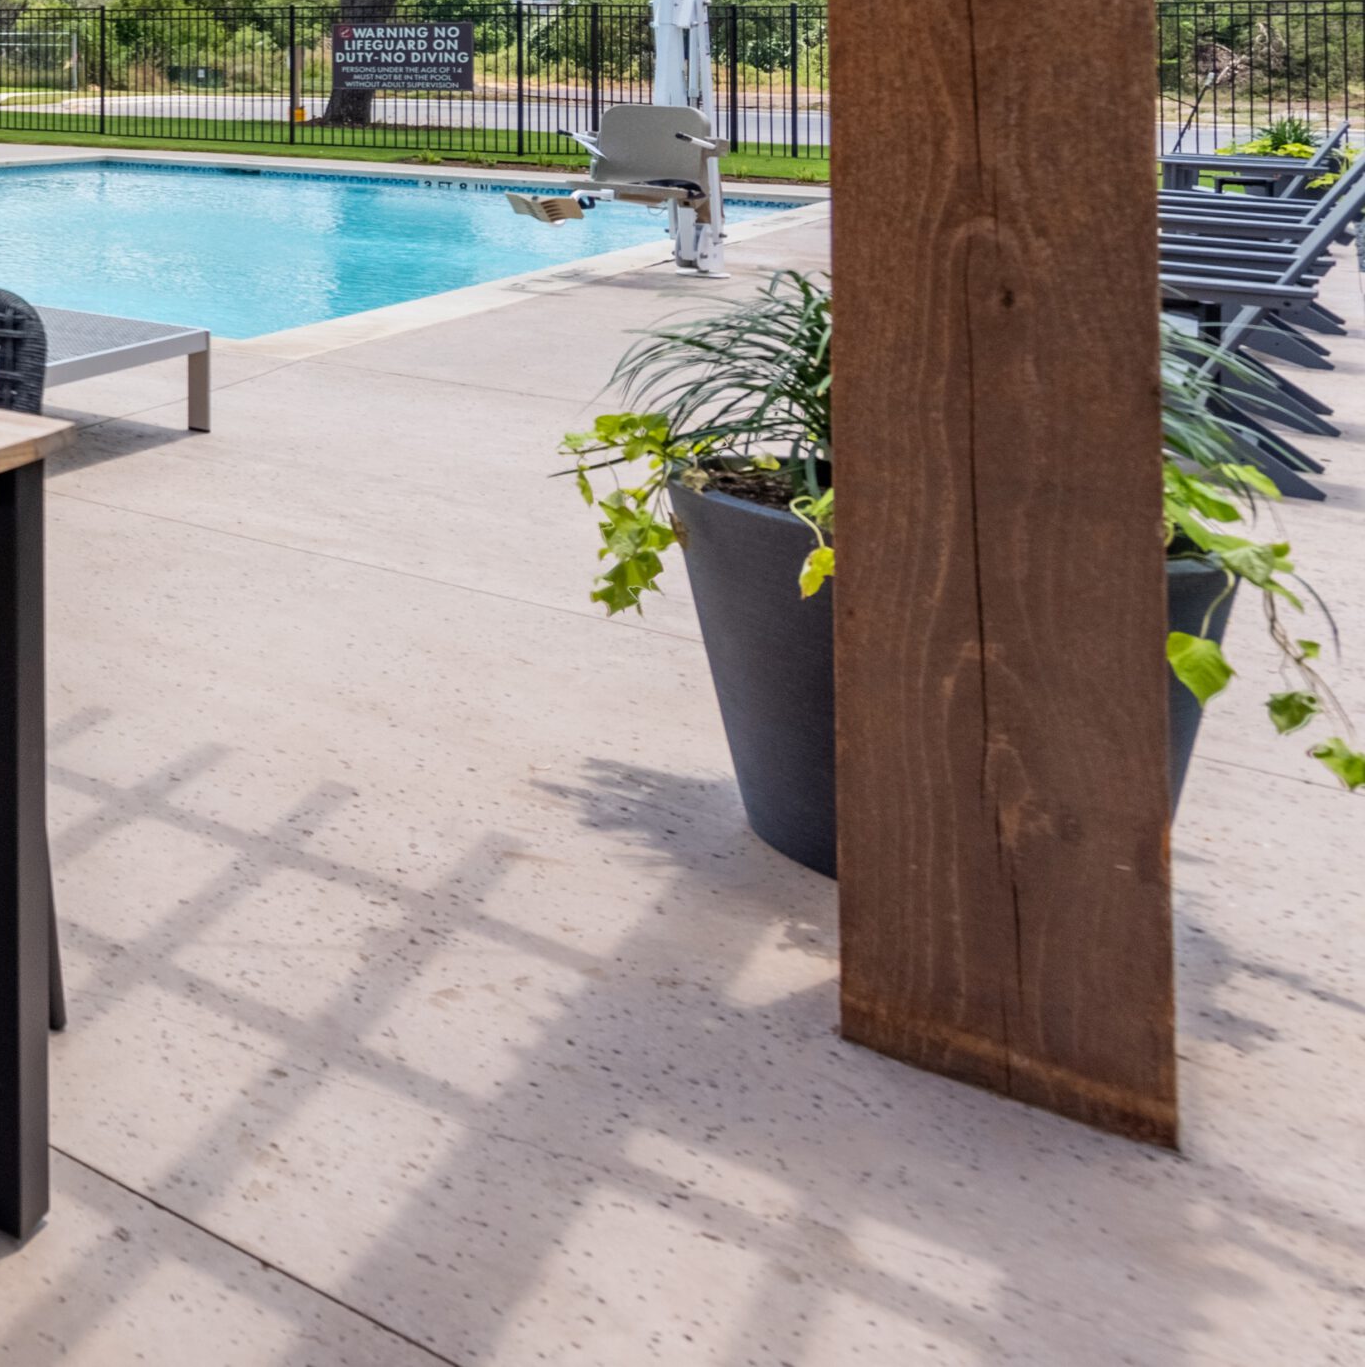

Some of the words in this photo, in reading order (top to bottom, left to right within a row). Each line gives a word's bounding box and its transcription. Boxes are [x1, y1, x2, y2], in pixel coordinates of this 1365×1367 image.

[353, 27, 428, 38] WARNING
[434, 27, 459, 38] NO
[344, 40, 427, 50] LIFEGUARD
[433, 40, 458, 50] ON
[336, 52, 405, 63] DUTY-NO
[411, 52, 469, 63] DIVING
